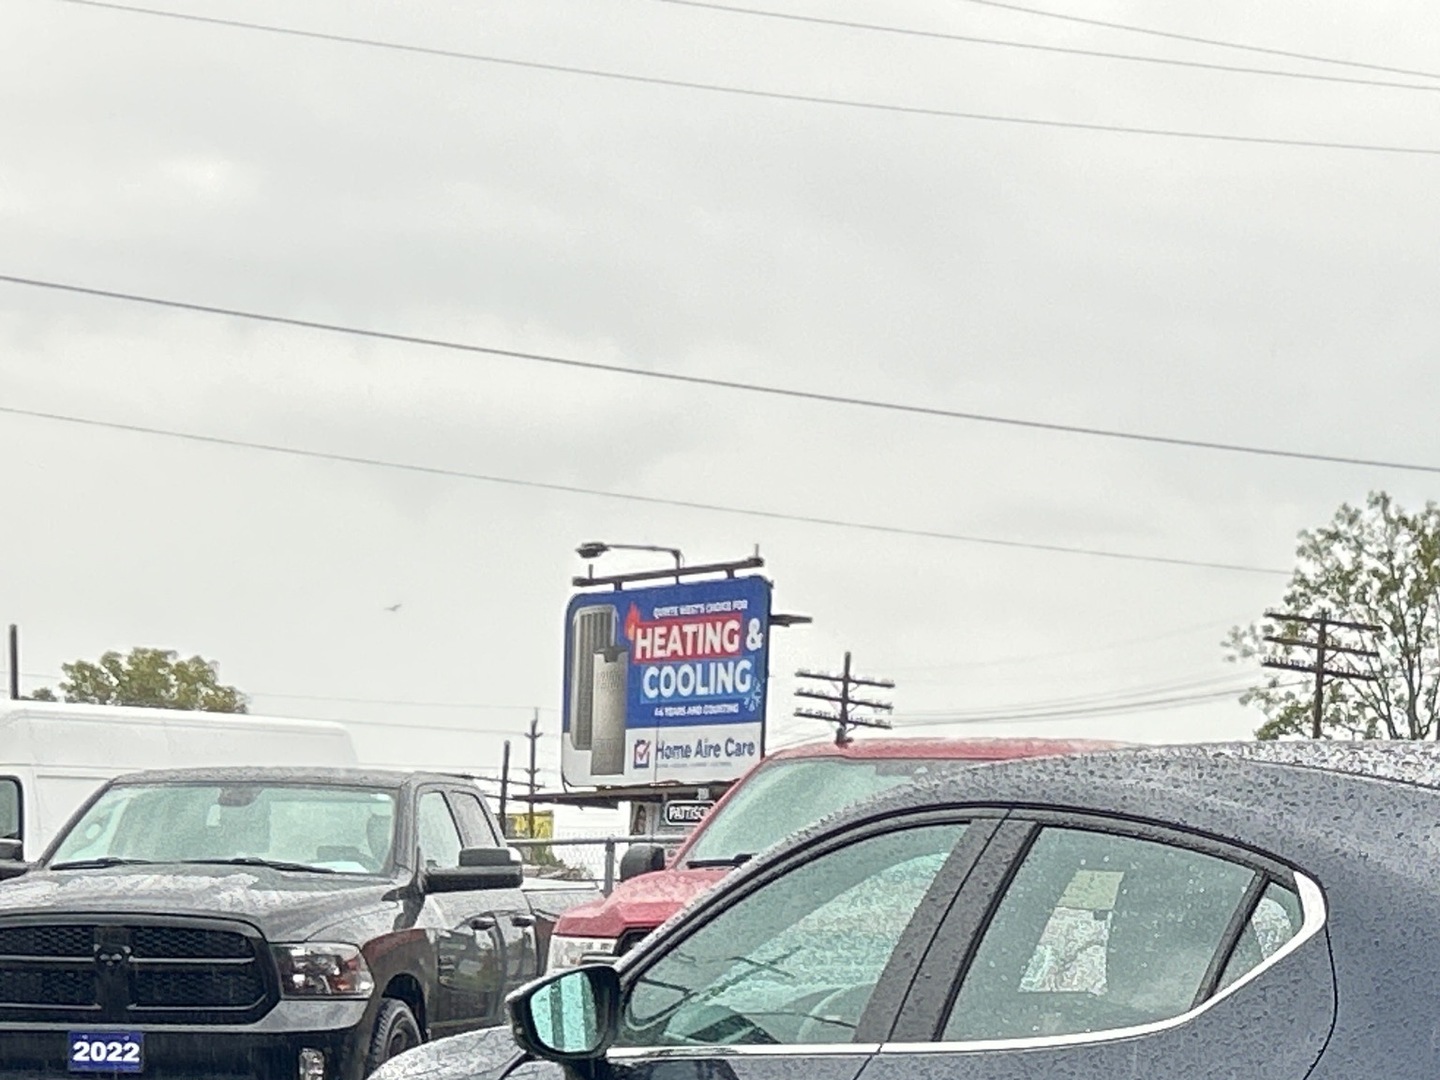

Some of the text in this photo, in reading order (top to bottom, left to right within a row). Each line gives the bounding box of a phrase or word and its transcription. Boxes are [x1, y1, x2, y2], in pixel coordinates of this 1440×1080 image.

[634, 618, 763, 660] HEATING &
[642, 659, 752, 699] COOLING
[656, 737, 756, 760] Home Aire Care
[72, 1041, 141, 1063] 2022
